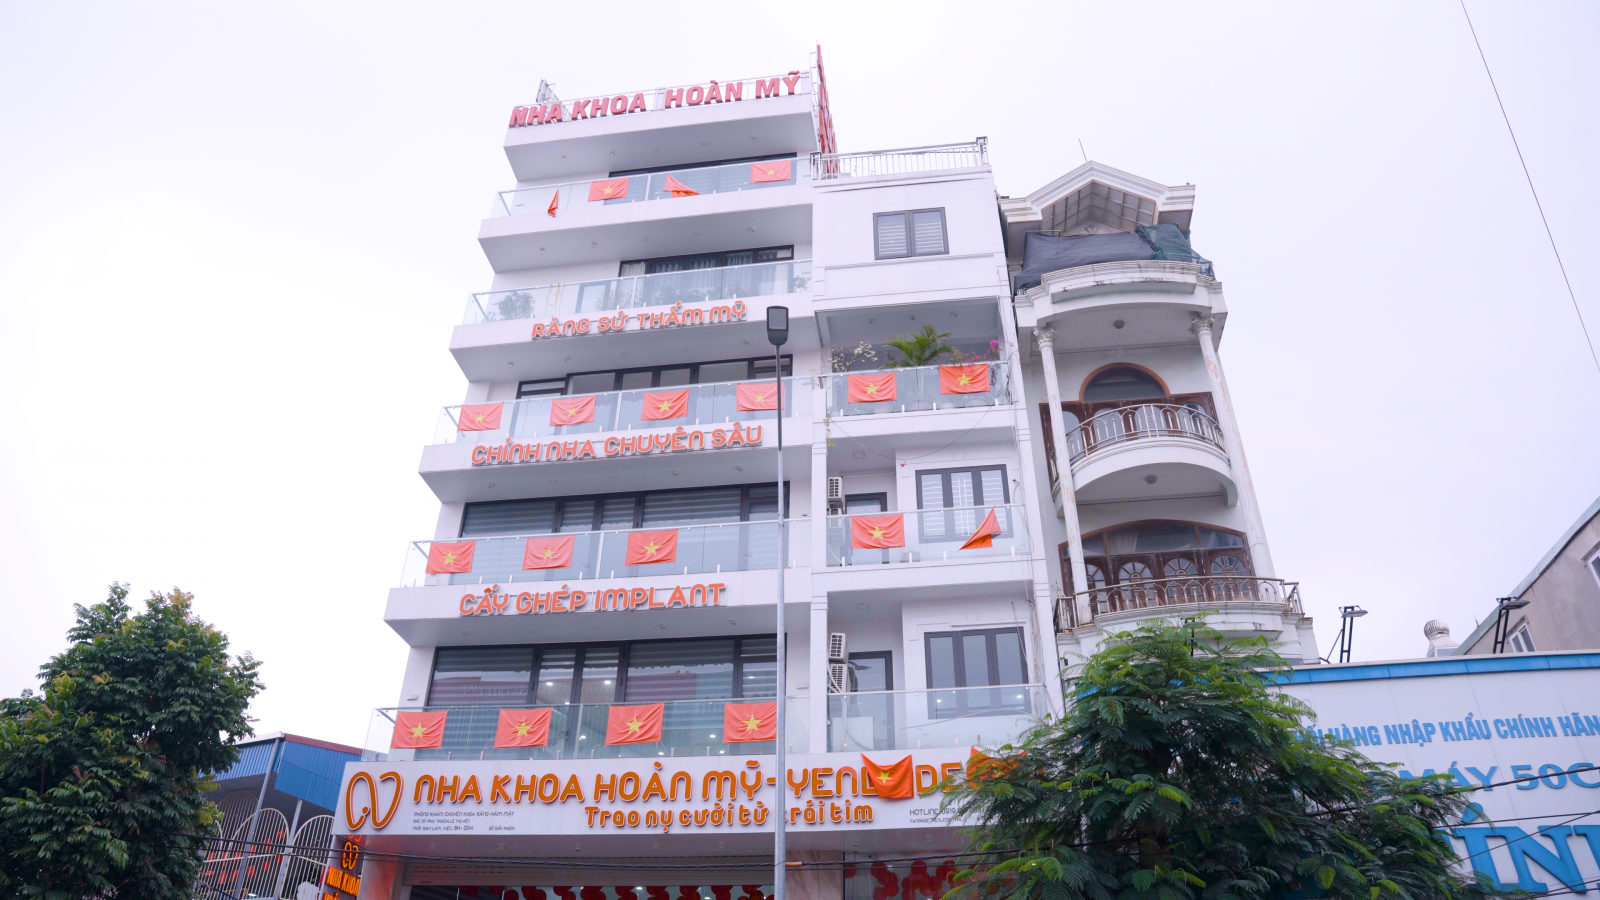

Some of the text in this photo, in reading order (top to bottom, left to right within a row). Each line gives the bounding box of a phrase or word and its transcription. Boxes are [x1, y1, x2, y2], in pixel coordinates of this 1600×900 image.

[508, 70, 801, 128] NHA KHOA HOÀN MỸ
[596, 310, 629, 332] SỨ
[546, 439, 596, 461] NHA
[603, 425, 704, 455] CHUYÊN
[711, 421, 762, 446] SÂU
[459, 583, 725, 615] CẤY GHÉP IMPLANT
[1327, 723, 1382, 748] HÀNG
[1383, 719, 1436, 747] NHẬP
[1438, 711, 1492, 742] KHẨU
[1493, 713, 1558, 739] CHÍNH
[413, 773, 482, 803] NHA
[489, 773, 584, 803] KHOA
[593, 761, 692, 802] HOÀN
[585, 806, 639, 827] Trao
[645, 809, 675, 833] nụ
[678, 802, 734, 827] cười
[830, 798, 874, 823] tim
[325, 866, 361, 897] NHA KHOA
